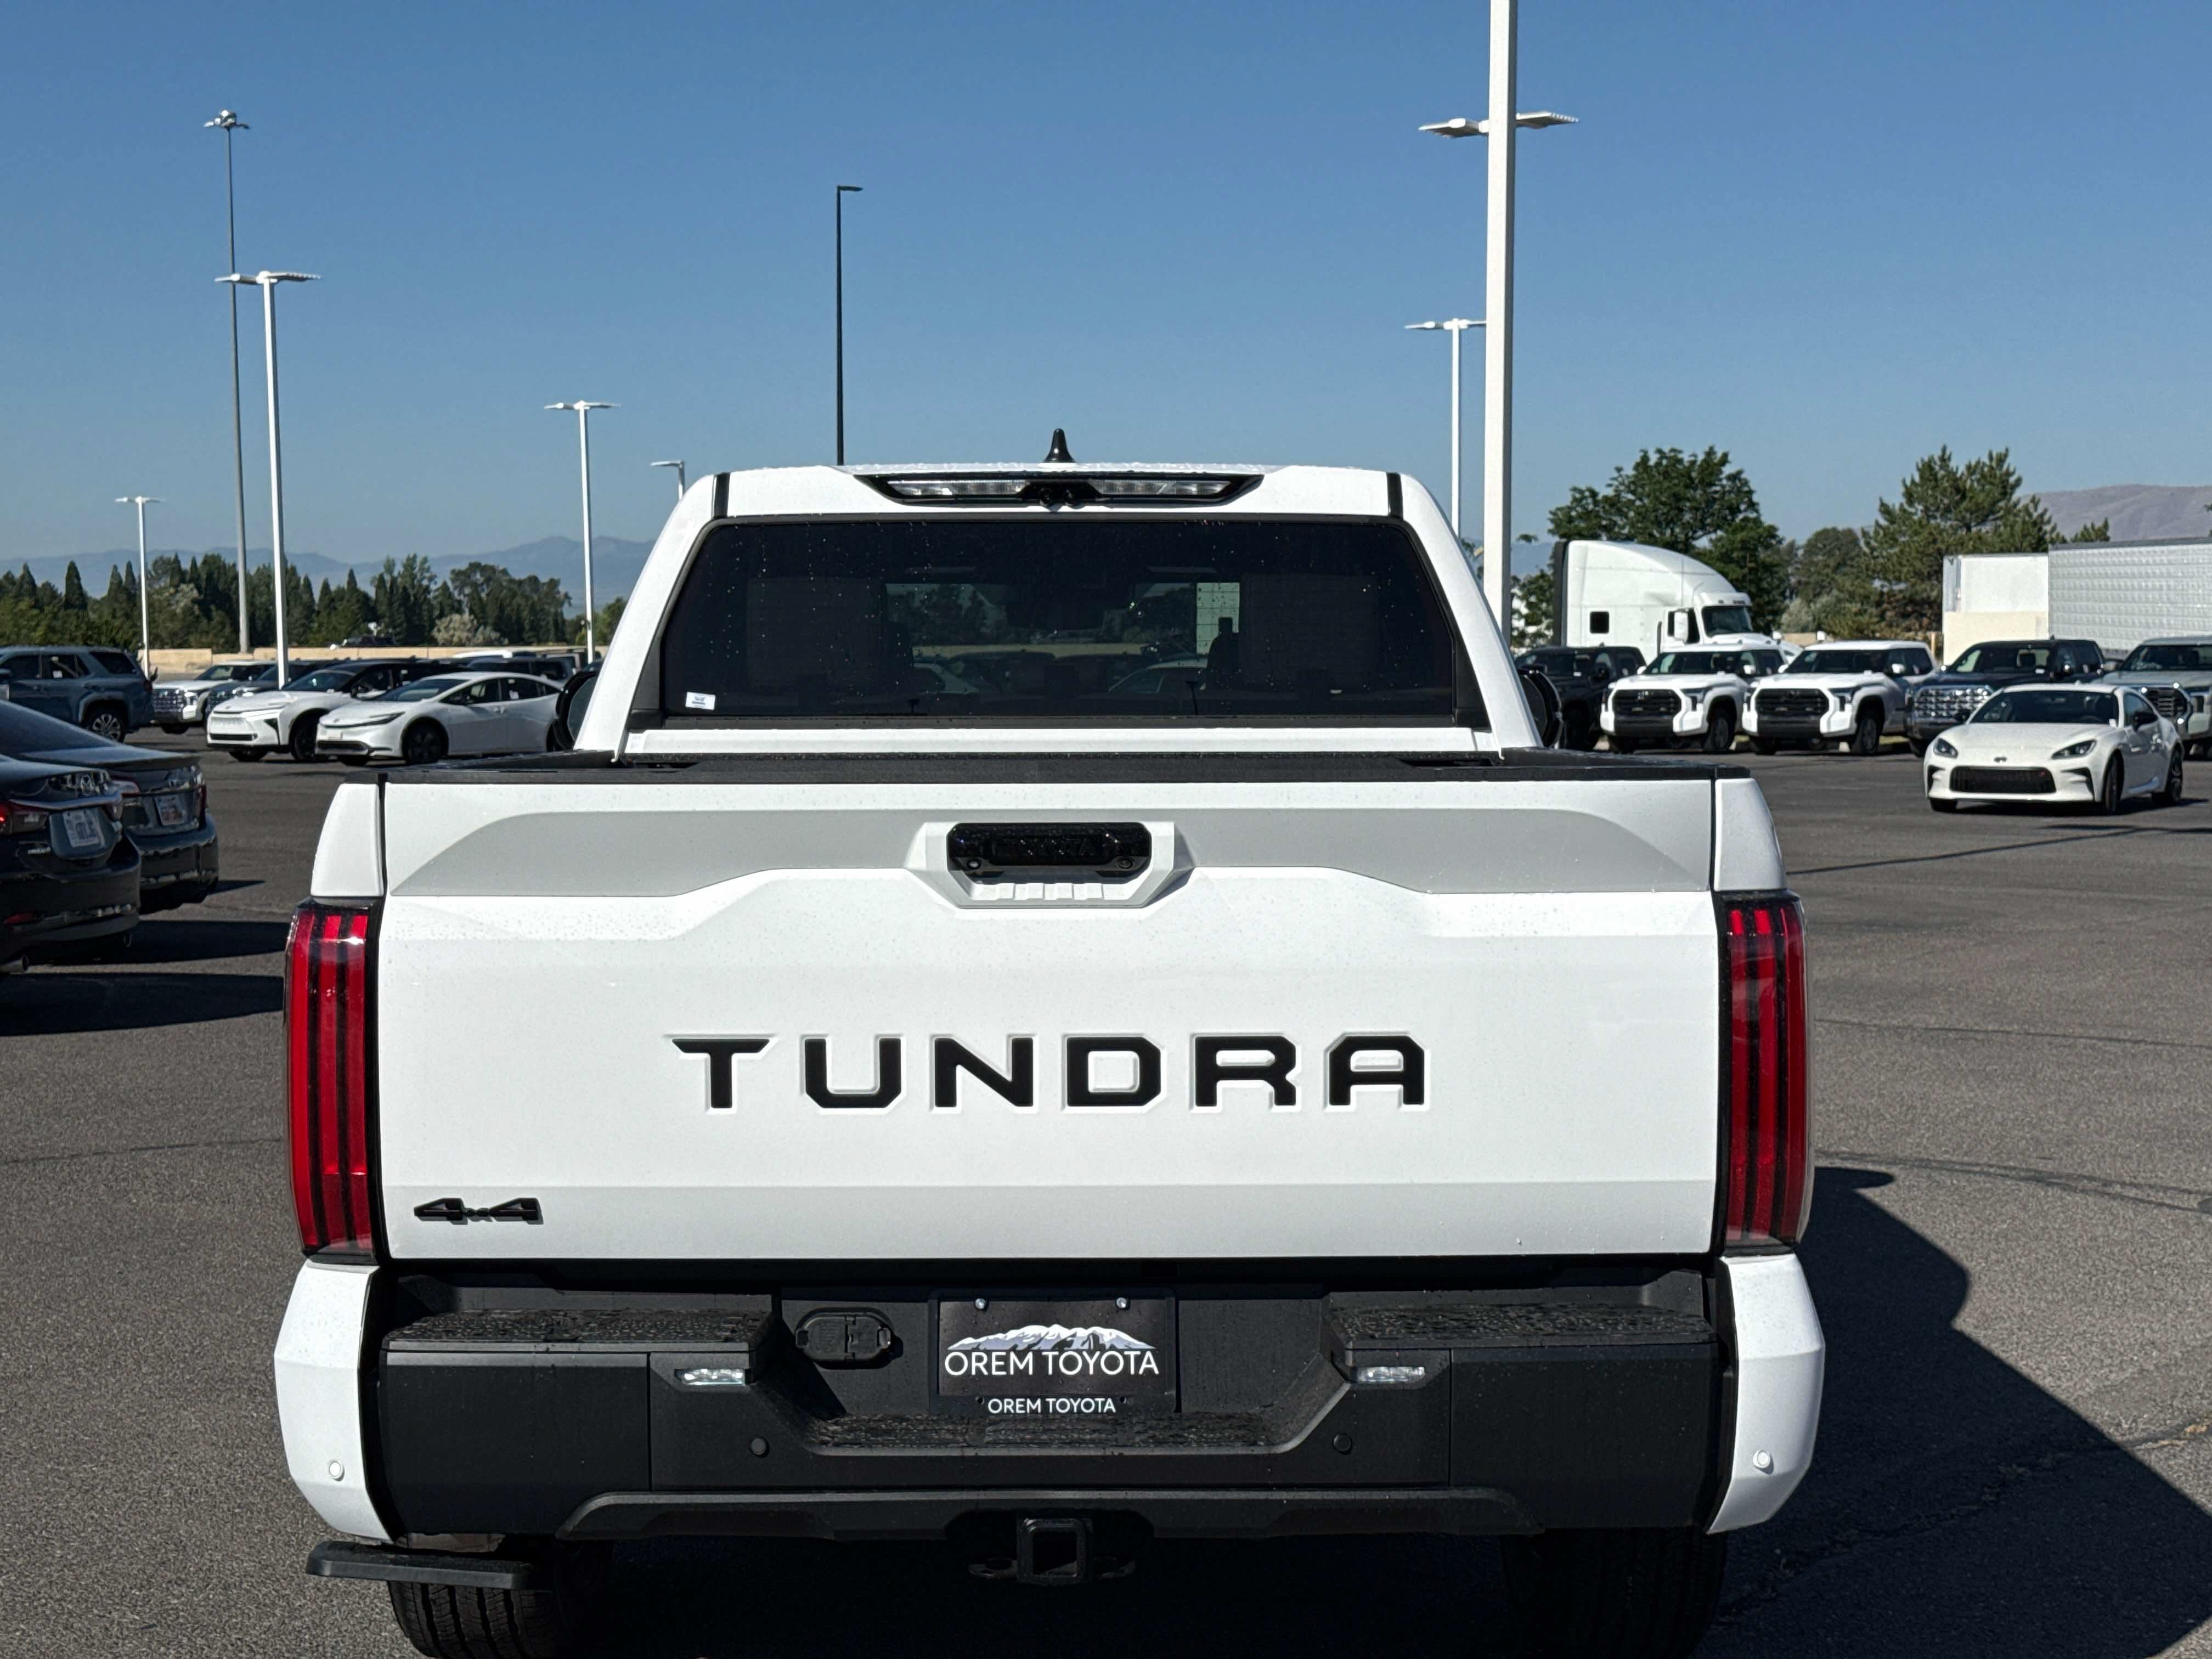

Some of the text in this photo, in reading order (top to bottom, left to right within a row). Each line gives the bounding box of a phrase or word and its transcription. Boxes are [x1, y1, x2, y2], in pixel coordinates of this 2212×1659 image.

[673, 1036, 1425, 1109] TUNDRA
[944, 1351, 1159, 1376] OREM TOYOTA
[988, 1397, 1116, 1414] OREM TOYOTA
